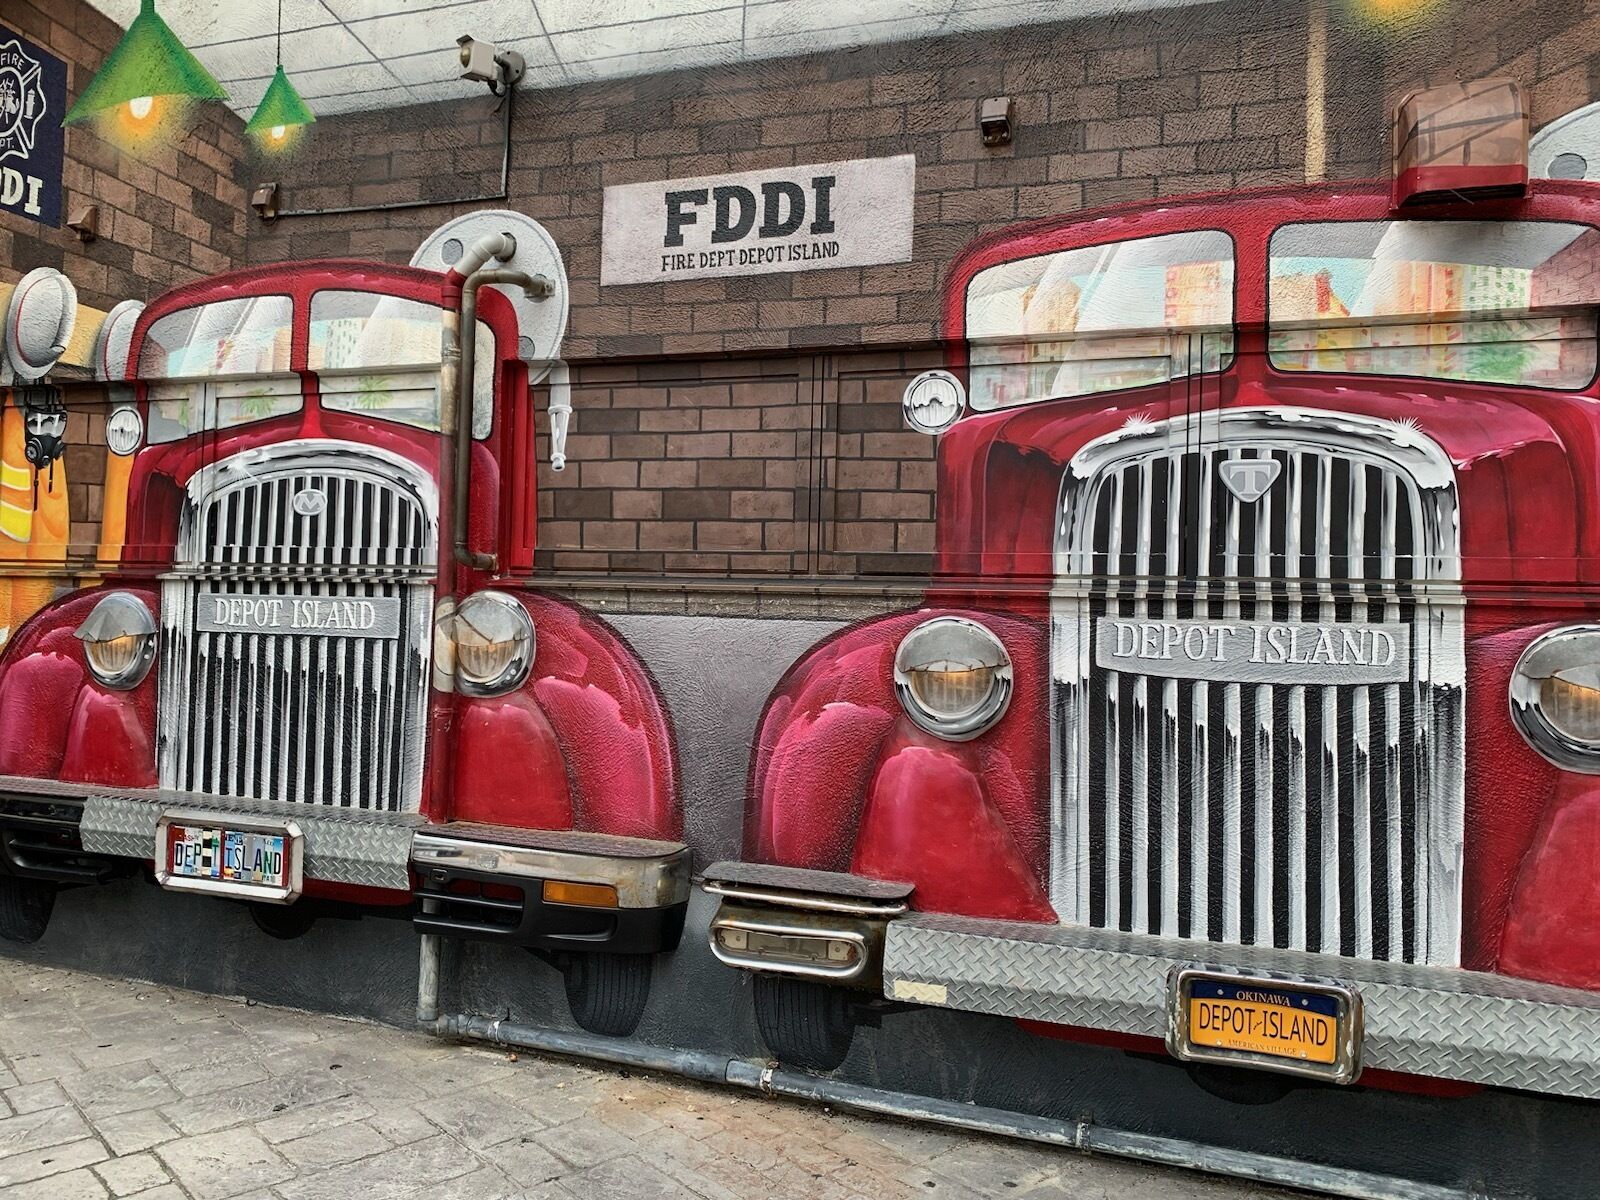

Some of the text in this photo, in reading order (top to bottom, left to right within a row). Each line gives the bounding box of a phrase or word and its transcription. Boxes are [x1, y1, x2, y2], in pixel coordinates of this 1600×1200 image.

[1, 52, 25, 70] FIRE
[0, 166, 43, 217] DI
[664, 175, 836, 248] FDDI
[661, 241, 840, 272] FIRE DEPT DEPOT ISLAND
[213, 597, 376, 630] DEPOT ISLAND
[1112, 622, 1397, 667] DEPOT ISLAND
[174, 842, 282, 875] DEPT ISLAND
[1236, 990, 1292, 1007] OKINAWA
[1199, 1002, 1328, 1046] DEPOT ISLAND
[1227, 1039, 1266, 1051] AMERICAN
